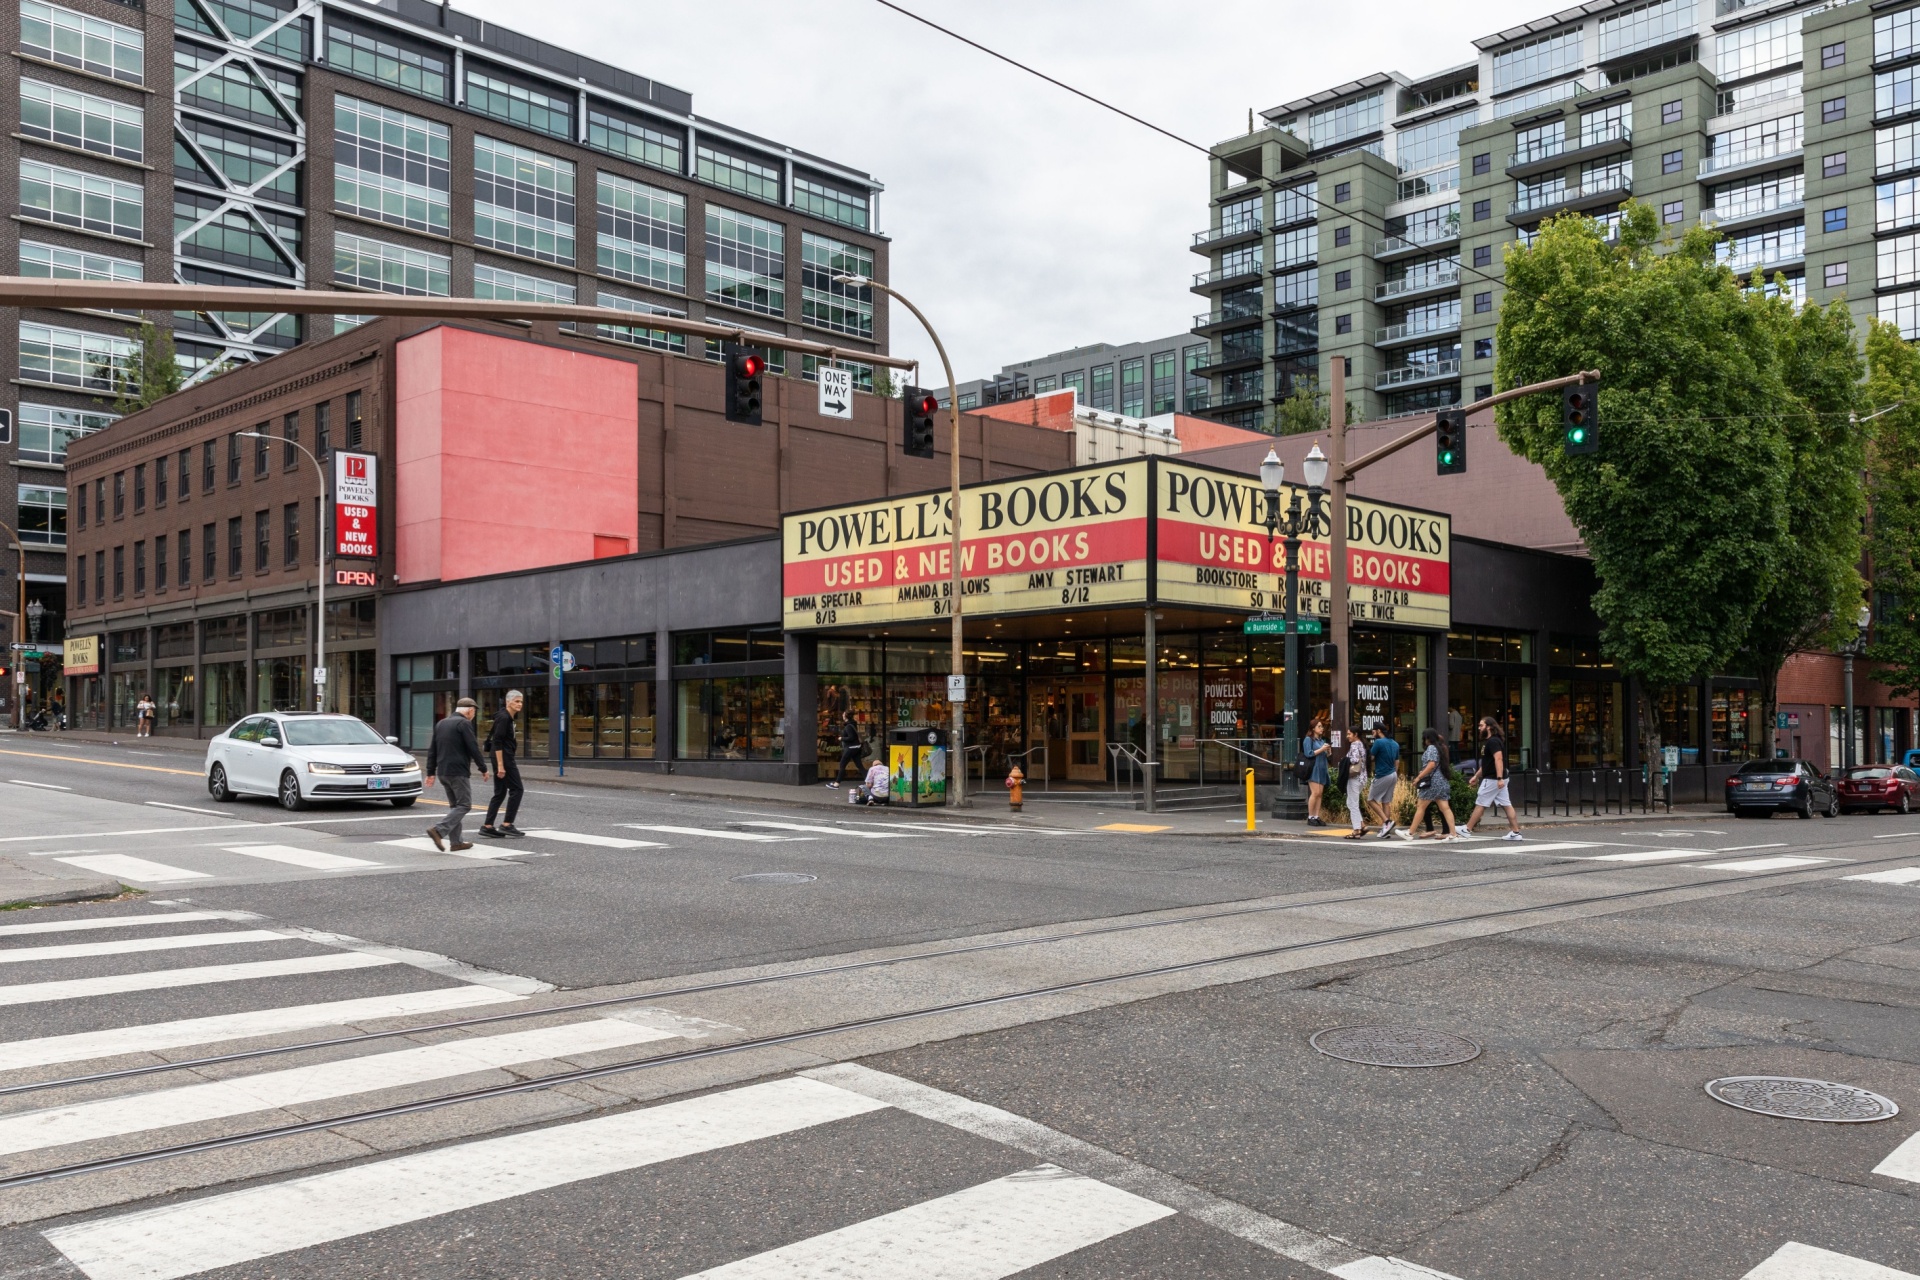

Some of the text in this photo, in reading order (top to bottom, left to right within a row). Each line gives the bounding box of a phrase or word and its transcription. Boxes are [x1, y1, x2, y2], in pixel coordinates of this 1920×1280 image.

[824, 371, 847, 385] ONE
[824, 384, 848, 398] WAY
[338, 485, 374, 495] POWELL'S
[344, 493, 369, 502] BOOKS
[344, 506, 369, 518] USED
[798, 470, 1127, 555] POWELL'S BOOKS
[352, 518, 361, 529] &
[1345, 504, 1442, 555] BOOKS
[345, 531, 367, 542] NEW
[340, 543, 373, 555] BOOKS
[824, 531, 1090, 587] USED & NEW BOOKS
[1200, 531, 1262, 566] USED
[1272, 542, 1287, 569] &
[1353, 554, 1421, 586] BOOKS
[336, 570, 375, 586] OPEN
[1196, 567, 1258, 589] BOOKSTORE
[1278, 576, 1322, 596] RANCE
[793, 564, 1125, 612] EMMA SPECTAR AMANDA BLOWS AMY STEWART
[815, 586, 1089, 625] 8/13 8/1 8/12
[1250, 592, 1264, 608] SO
[1300, 598, 1312, 613] WE
[1371, 605, 1395, 620] TWICE
[1252, 622, 1278, 631] Burnside
[70, 638, 92, 651] POWELL'S
[72, 652, 88, 664] BOOKS
[1204, 684, 1244, 698] POWELL'S
[1357, 684, 1389, 701] POWELL'S
[897, 696, 933, 706] Travel
[1214, 699, 1238, 709] city of
[1366, 702, 1381, 713] city of
[897, 707, 909, 717] to
[1210, 710, 1237, 724] BOOKS
[897, 719, 941, 728] another
